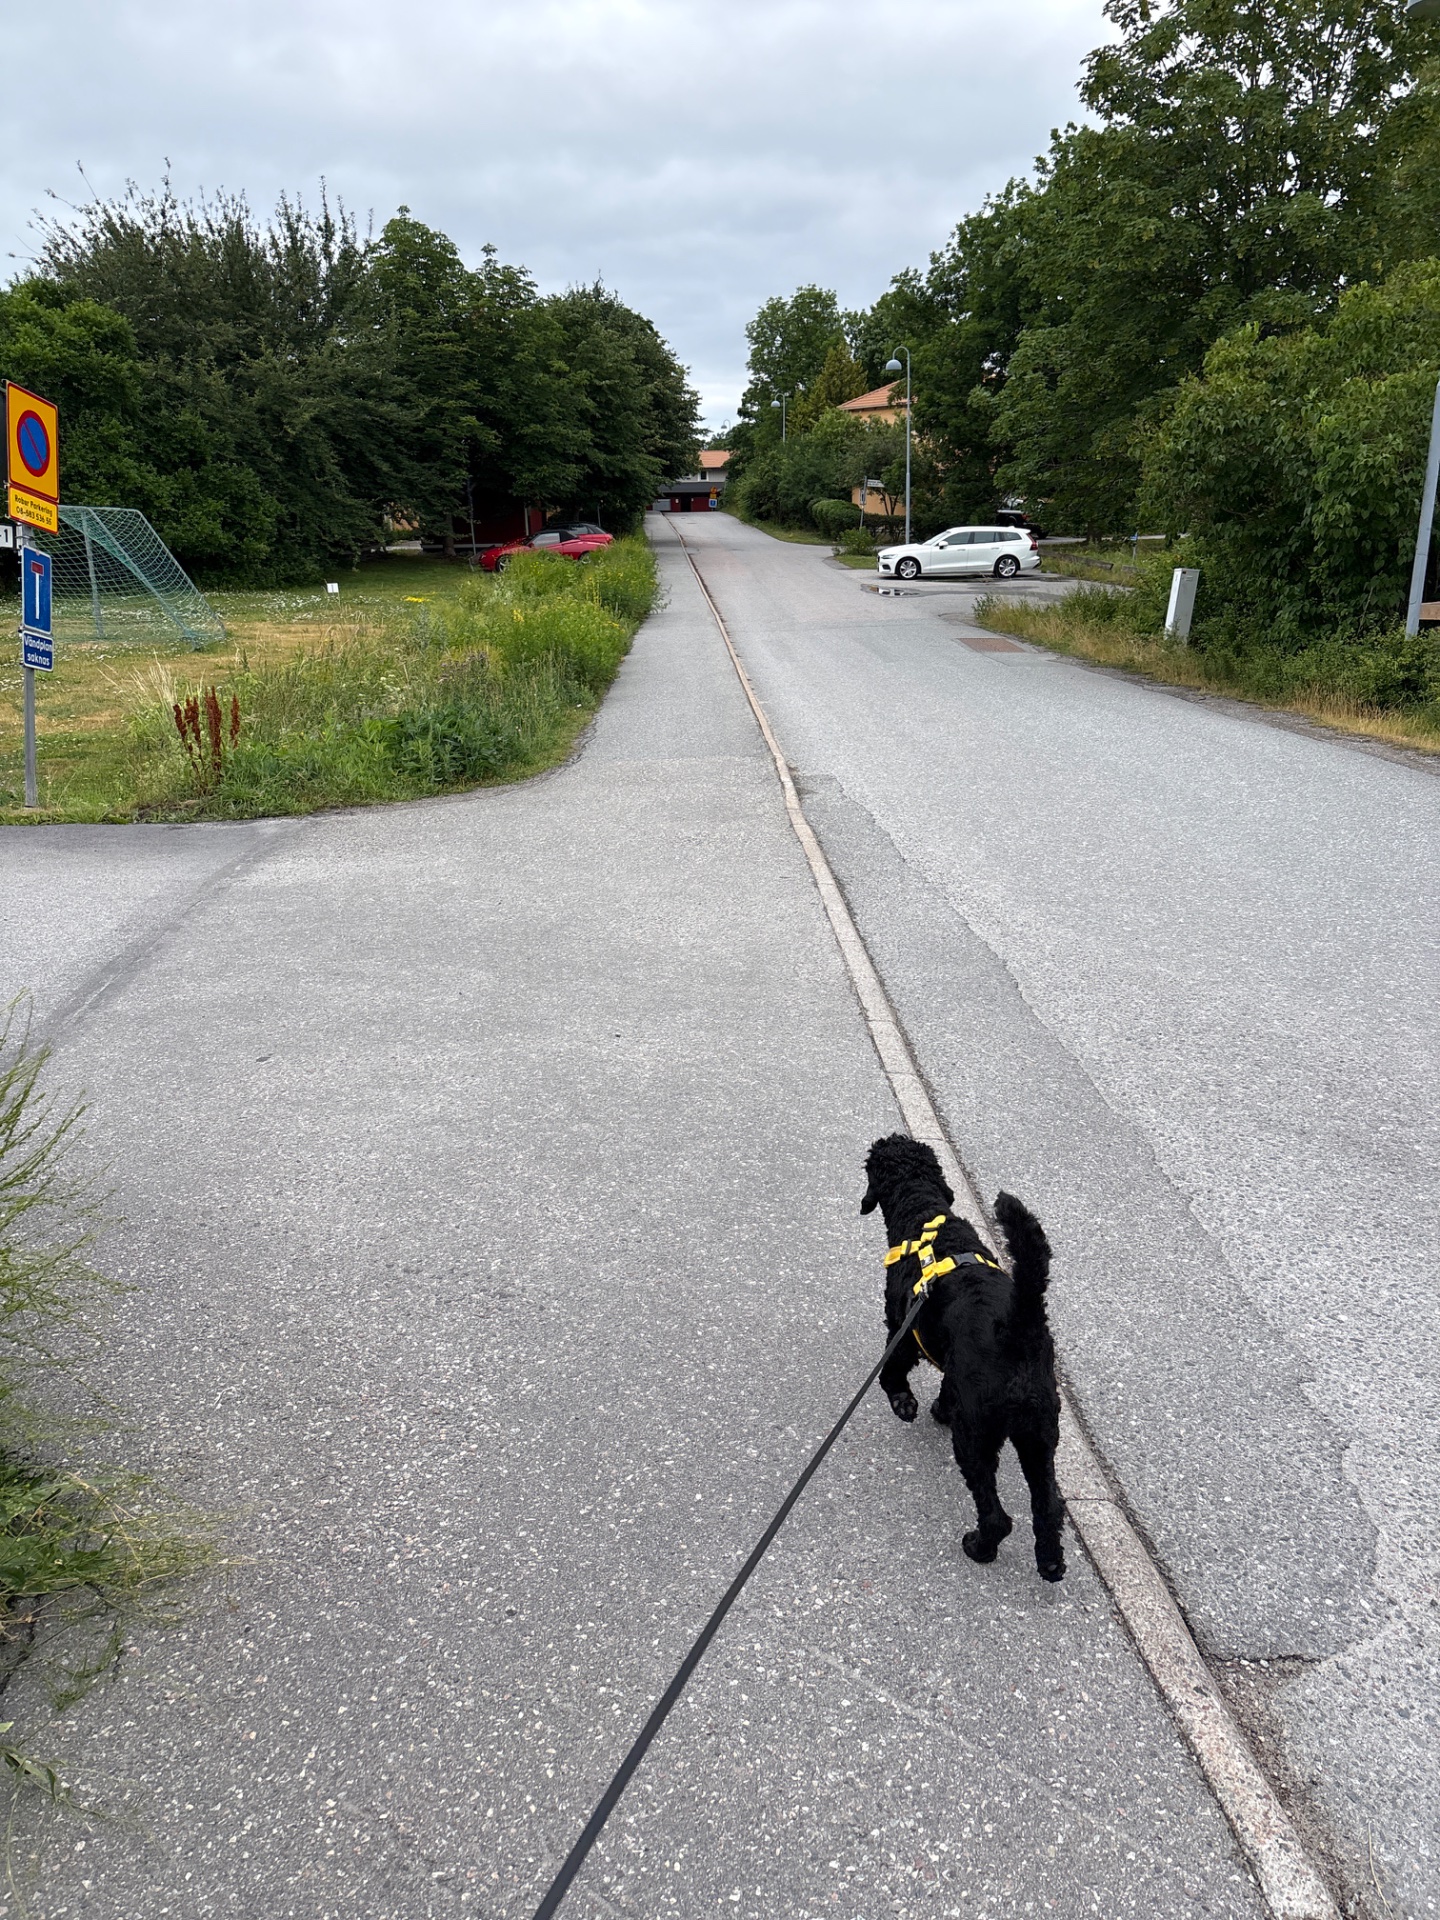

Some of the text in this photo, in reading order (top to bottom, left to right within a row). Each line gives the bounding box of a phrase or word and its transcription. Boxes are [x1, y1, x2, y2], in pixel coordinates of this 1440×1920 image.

[30, 501, 52, 517] Parkering
[24, 635, 52, 652] Vändplan
[27, 653, 50, 666] saknas
